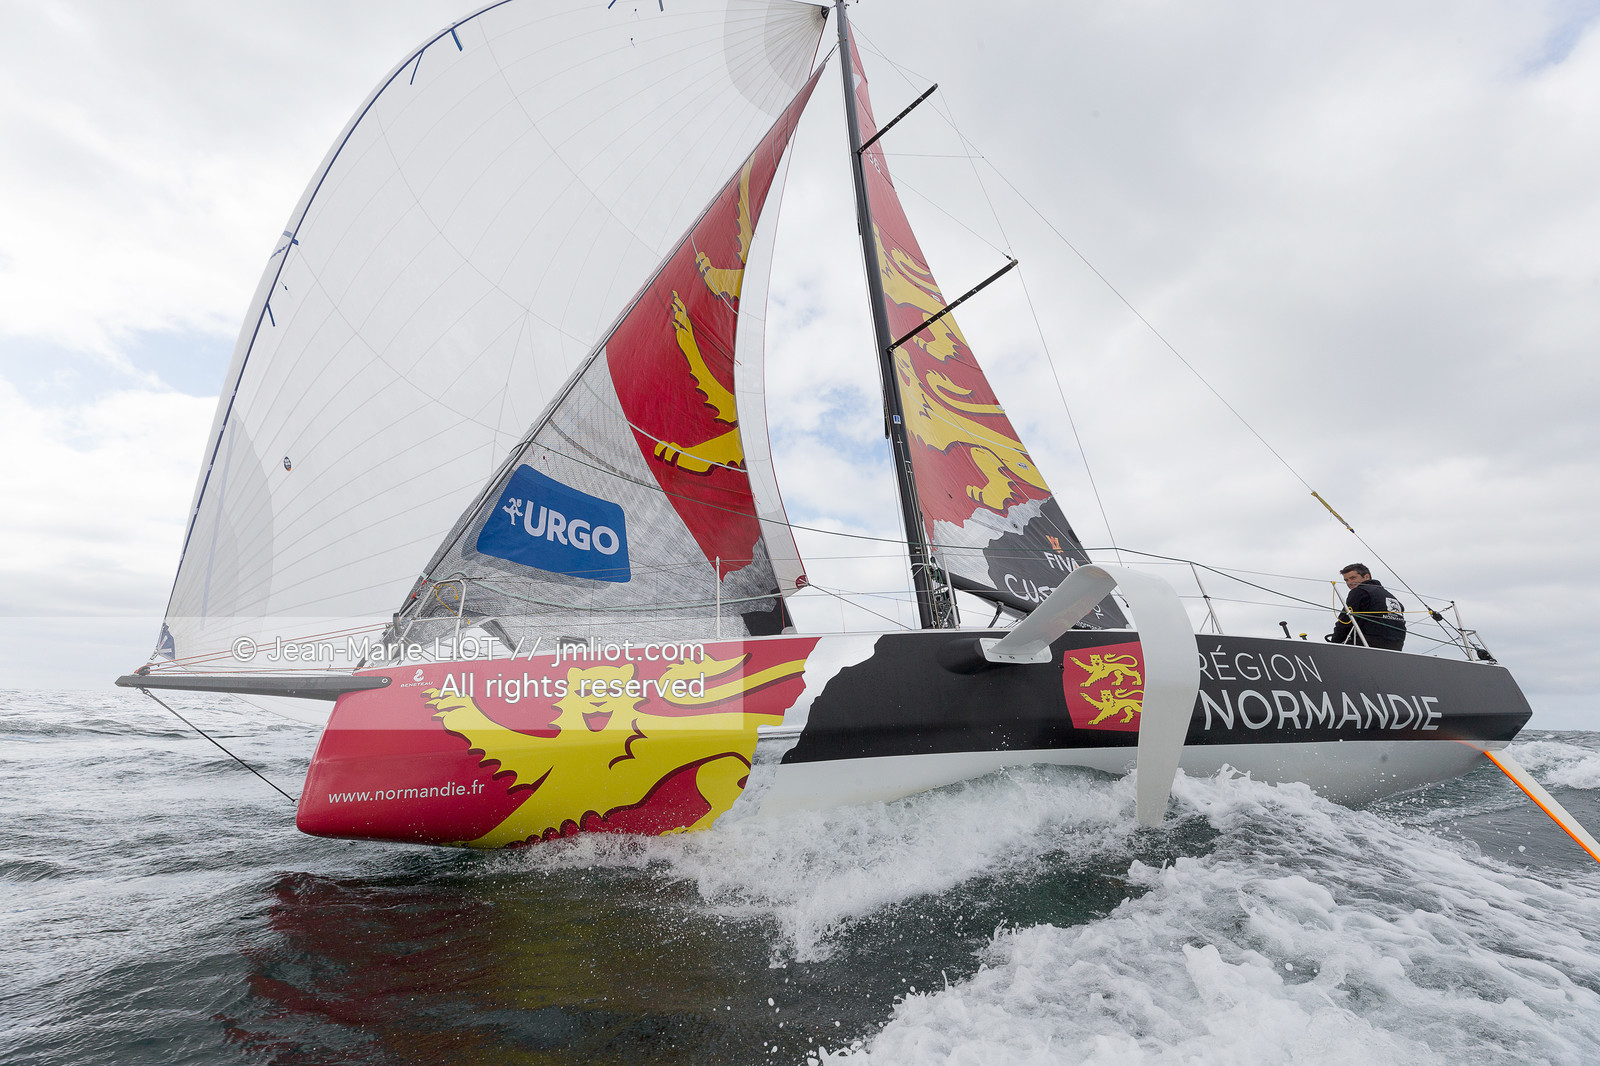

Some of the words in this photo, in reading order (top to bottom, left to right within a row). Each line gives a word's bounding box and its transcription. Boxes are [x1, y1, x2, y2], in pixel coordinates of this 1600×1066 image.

[523, 500, 620, 555] URGO
[1199, 690, 1442, 731] NORMANDIE
[328, 779, 485, 804] www.normandie.fr
